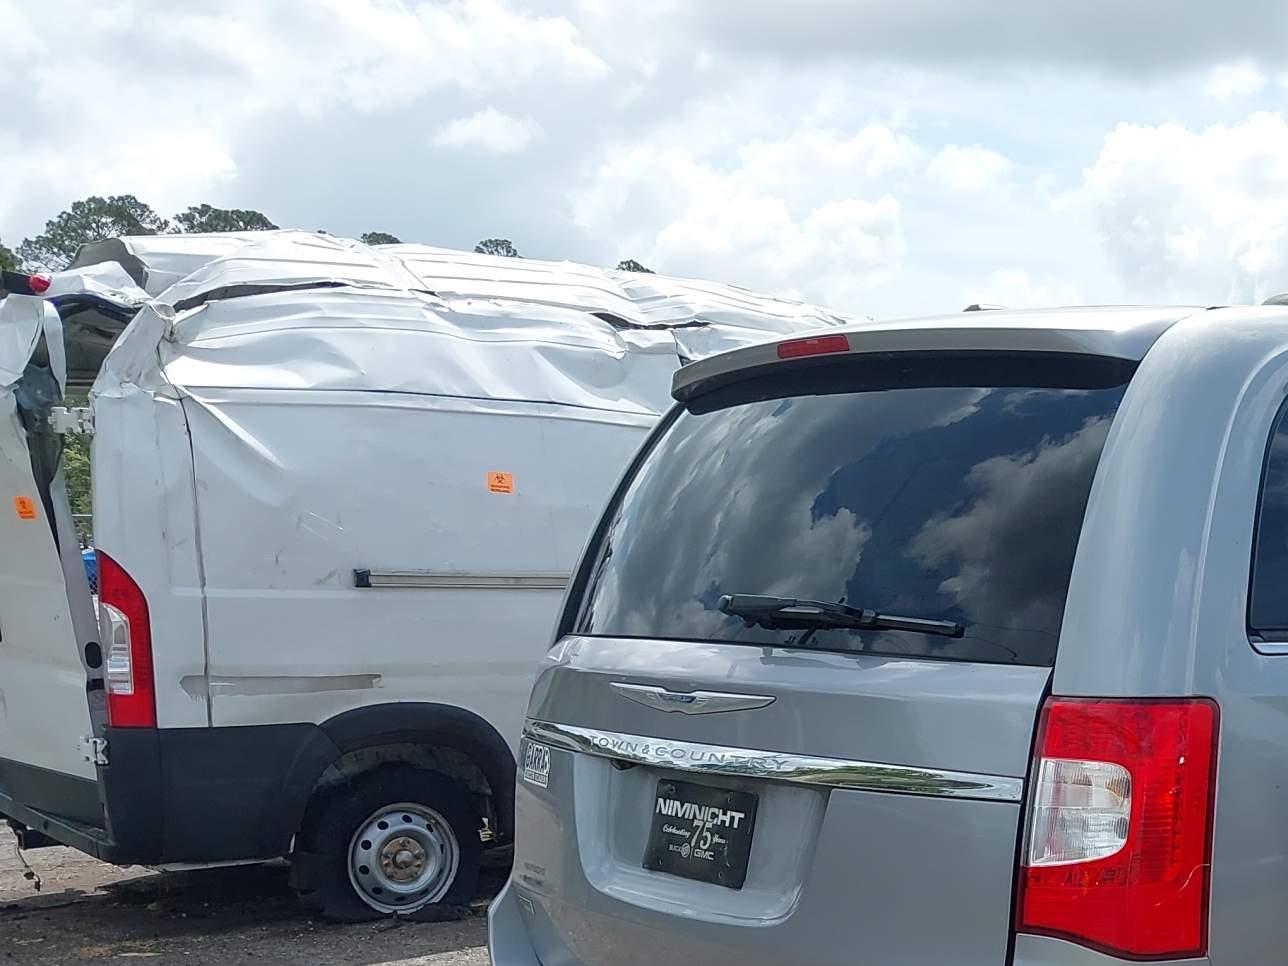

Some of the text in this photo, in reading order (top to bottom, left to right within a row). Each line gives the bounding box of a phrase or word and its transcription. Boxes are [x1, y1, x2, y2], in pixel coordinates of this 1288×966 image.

[655, 798, 745, 829] NIMNICHT
[690, 819, 713, 850] 75
[693, 848, 715, 861] GMC
